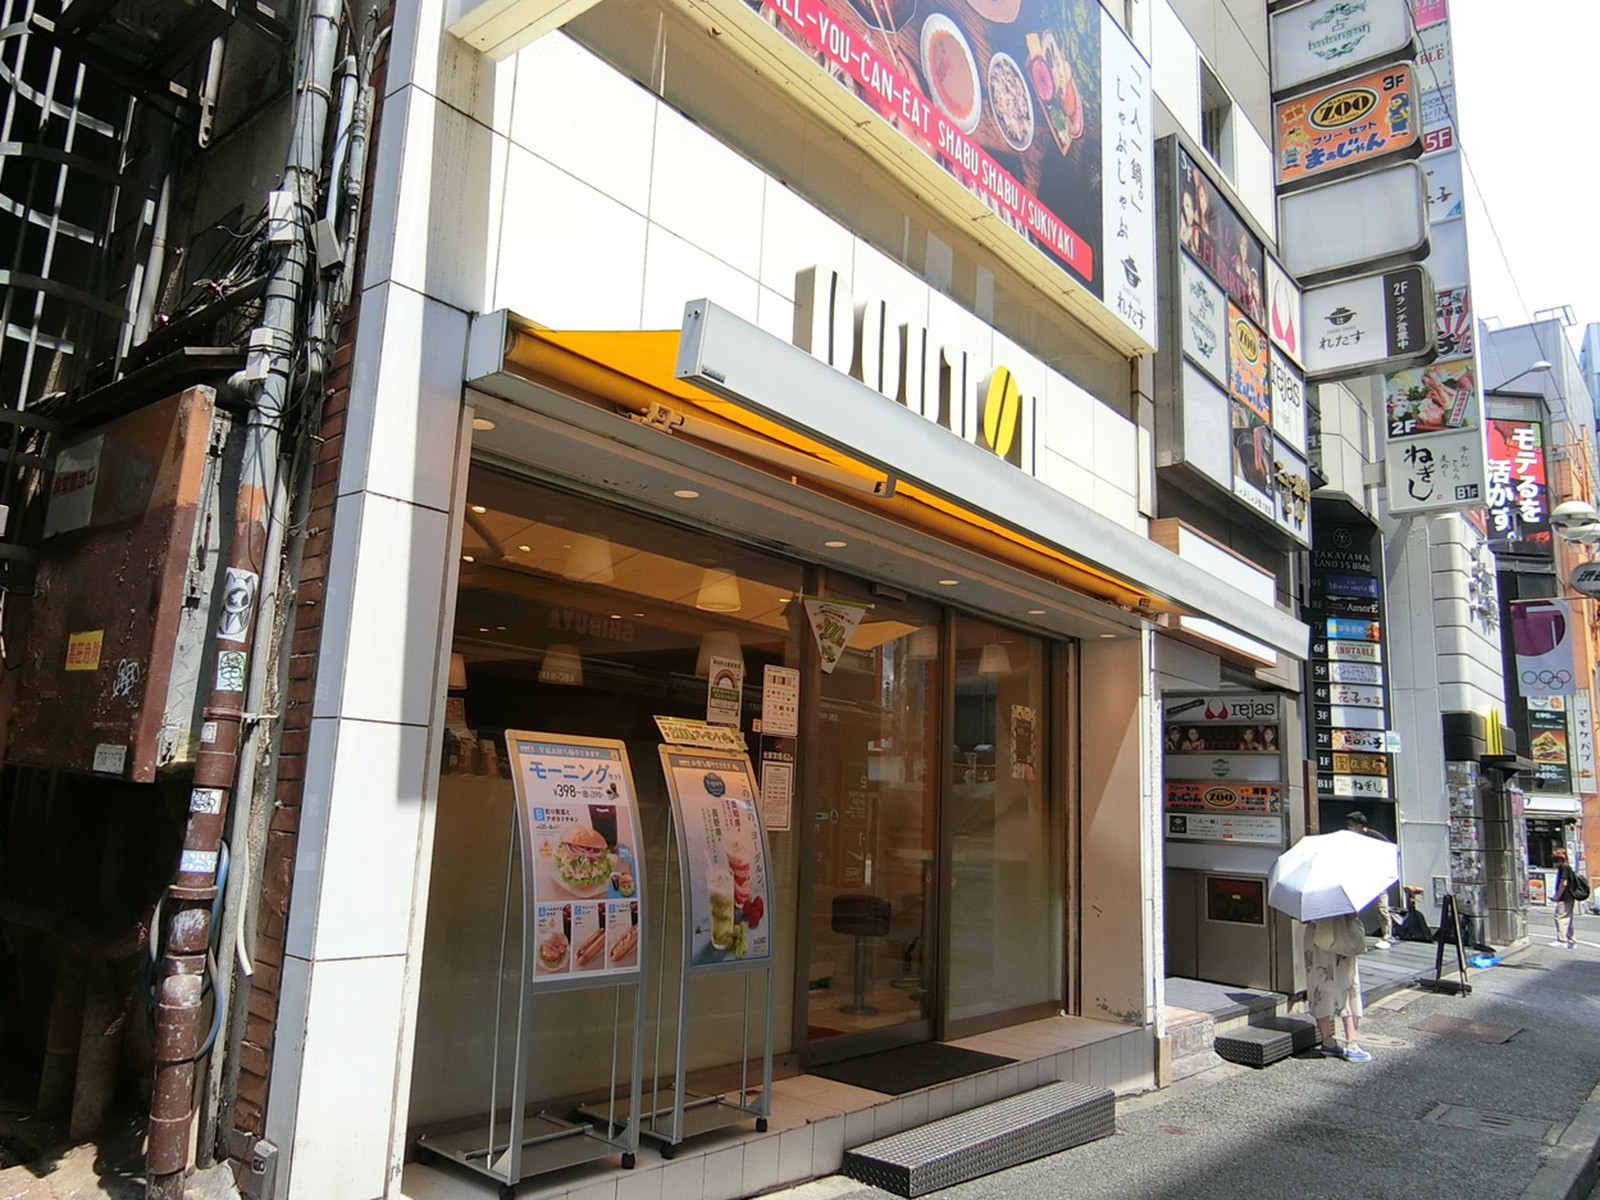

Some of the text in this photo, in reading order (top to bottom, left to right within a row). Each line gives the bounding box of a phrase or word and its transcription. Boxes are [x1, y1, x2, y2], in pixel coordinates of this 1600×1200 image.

[1383, 75, 1405, 91] 3F
[1320, 96, 1370, 122] ZOO
[775, 0, 930, 134] L-YOU-CAN-EAT
[938, 120, 979, 176] SHABU
[981, 159, 1019, 211] SHABU
[1027, 200, 1074, 261] SUKIYAKI
[1312, 121, 1377, 146] フリー セット
[1426, 128, 1451, 152] 5F
[1115, 75, 1128, 240] しゃぶしゃぶ
[1305, 132, 1387, 170] まぁじゃん
[1393, 281, 1408, 296] 2F
[1117, 290, 1147, 331] れたす
[1395, 296, 1410, 350] ランチ営業中
[1319, 330, 1366, 351] れたす
[1271, 361, 1301, 408] rejas
[1391, 419, 1417, 435] 2F
[1403, 443, 1437, 502] ねぎし
[1511, 428, 1542, 523] モテるを
[1456, 486, 1478, 499] B1F
[1313, 550, 1370, 562] TAKAYAMA
[1314, 559, 1338, 569] LAND
[1313, 643, 1325, 653] 6F
[1315, 665, 1327, 675] 5F
[1315, 688, 1328, 698] 4F
[1231, 699, 1275, 720] rejas
[1317, 710, 1329, 721] 3F
[1317, 733, 1330, 743] 2F
[1319, 756, 1331, 766] 1F
[529, 760, 610, 784] モーニング
[1351, 779, 1384, 793] ねぎし
[1208, 793, 1233, 802] ZOO
